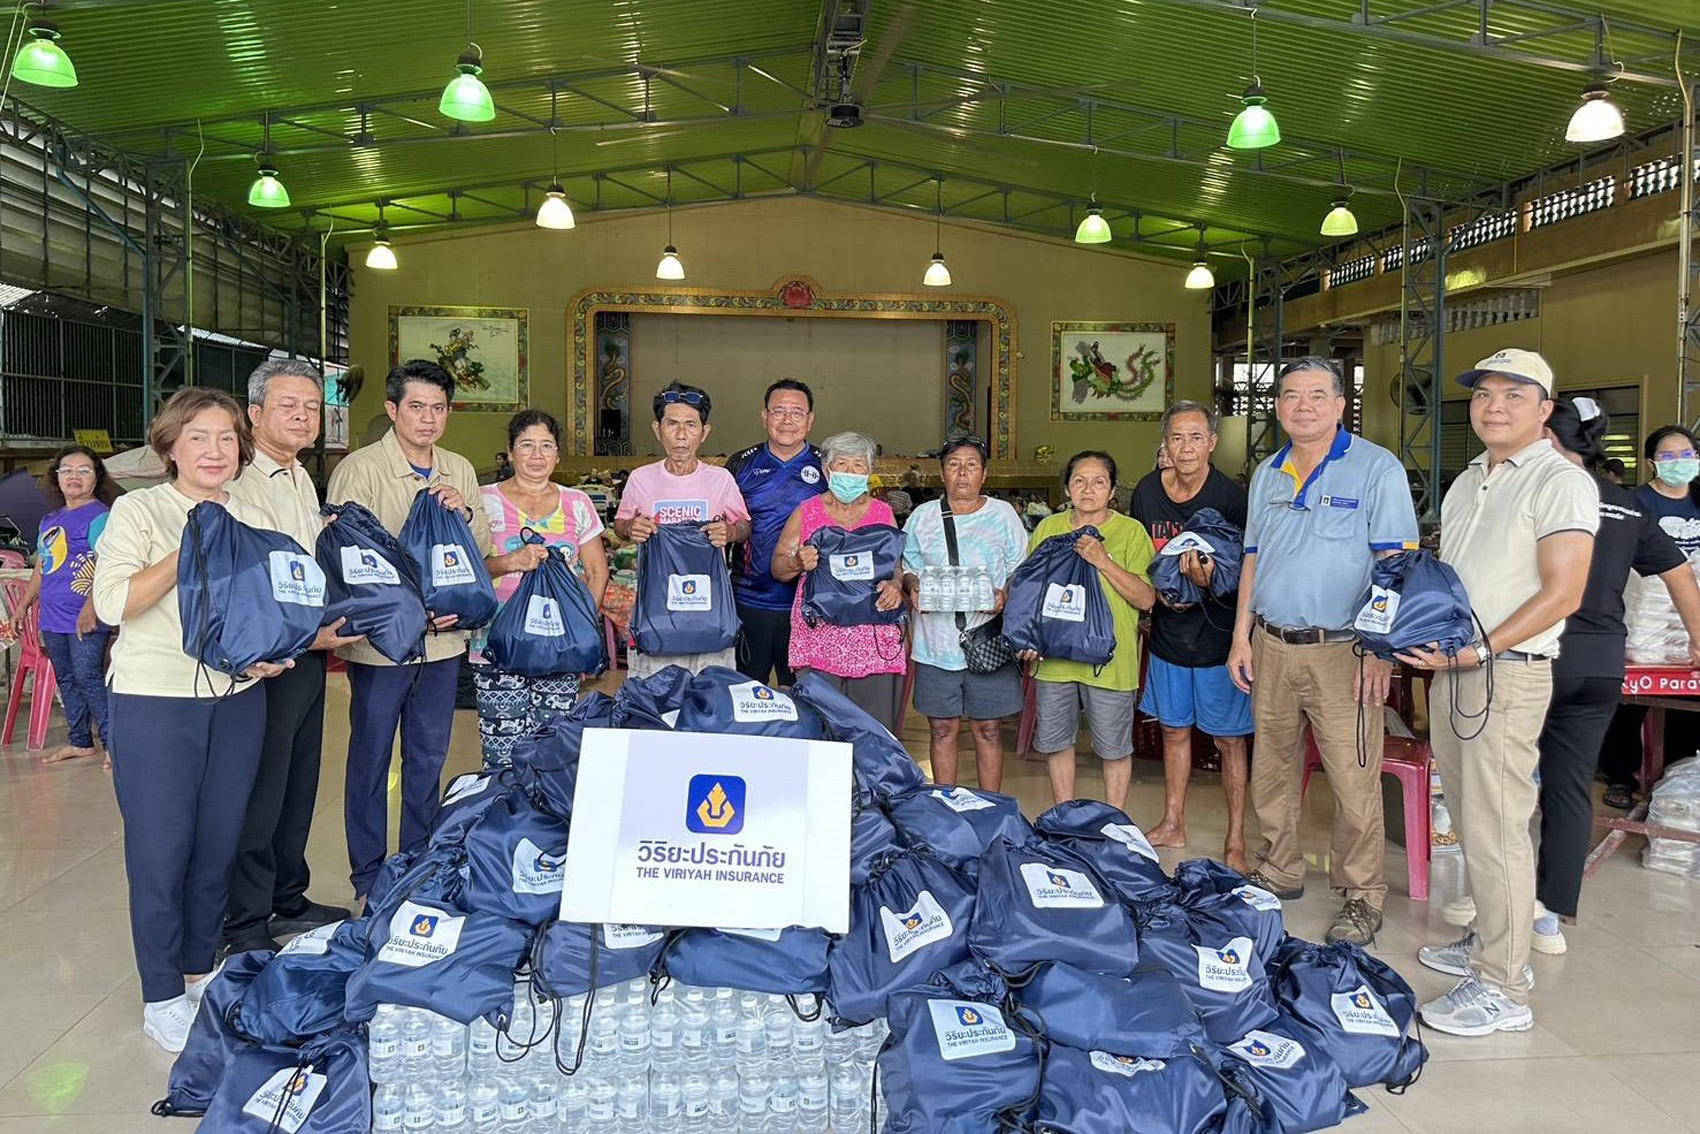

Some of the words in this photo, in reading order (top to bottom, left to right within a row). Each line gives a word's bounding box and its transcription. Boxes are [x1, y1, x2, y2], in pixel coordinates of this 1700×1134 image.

[660, 505, 701, 517] SCENIC
[1660, 678, 1700, 690] Para
[637, 840, 786, 868] วิริยะประกันภัย
[636, 867, 660, 878] THE
[664, 868, 712, 880] VIRIYAH
[715, 870, 785, 884] INSURANCE
